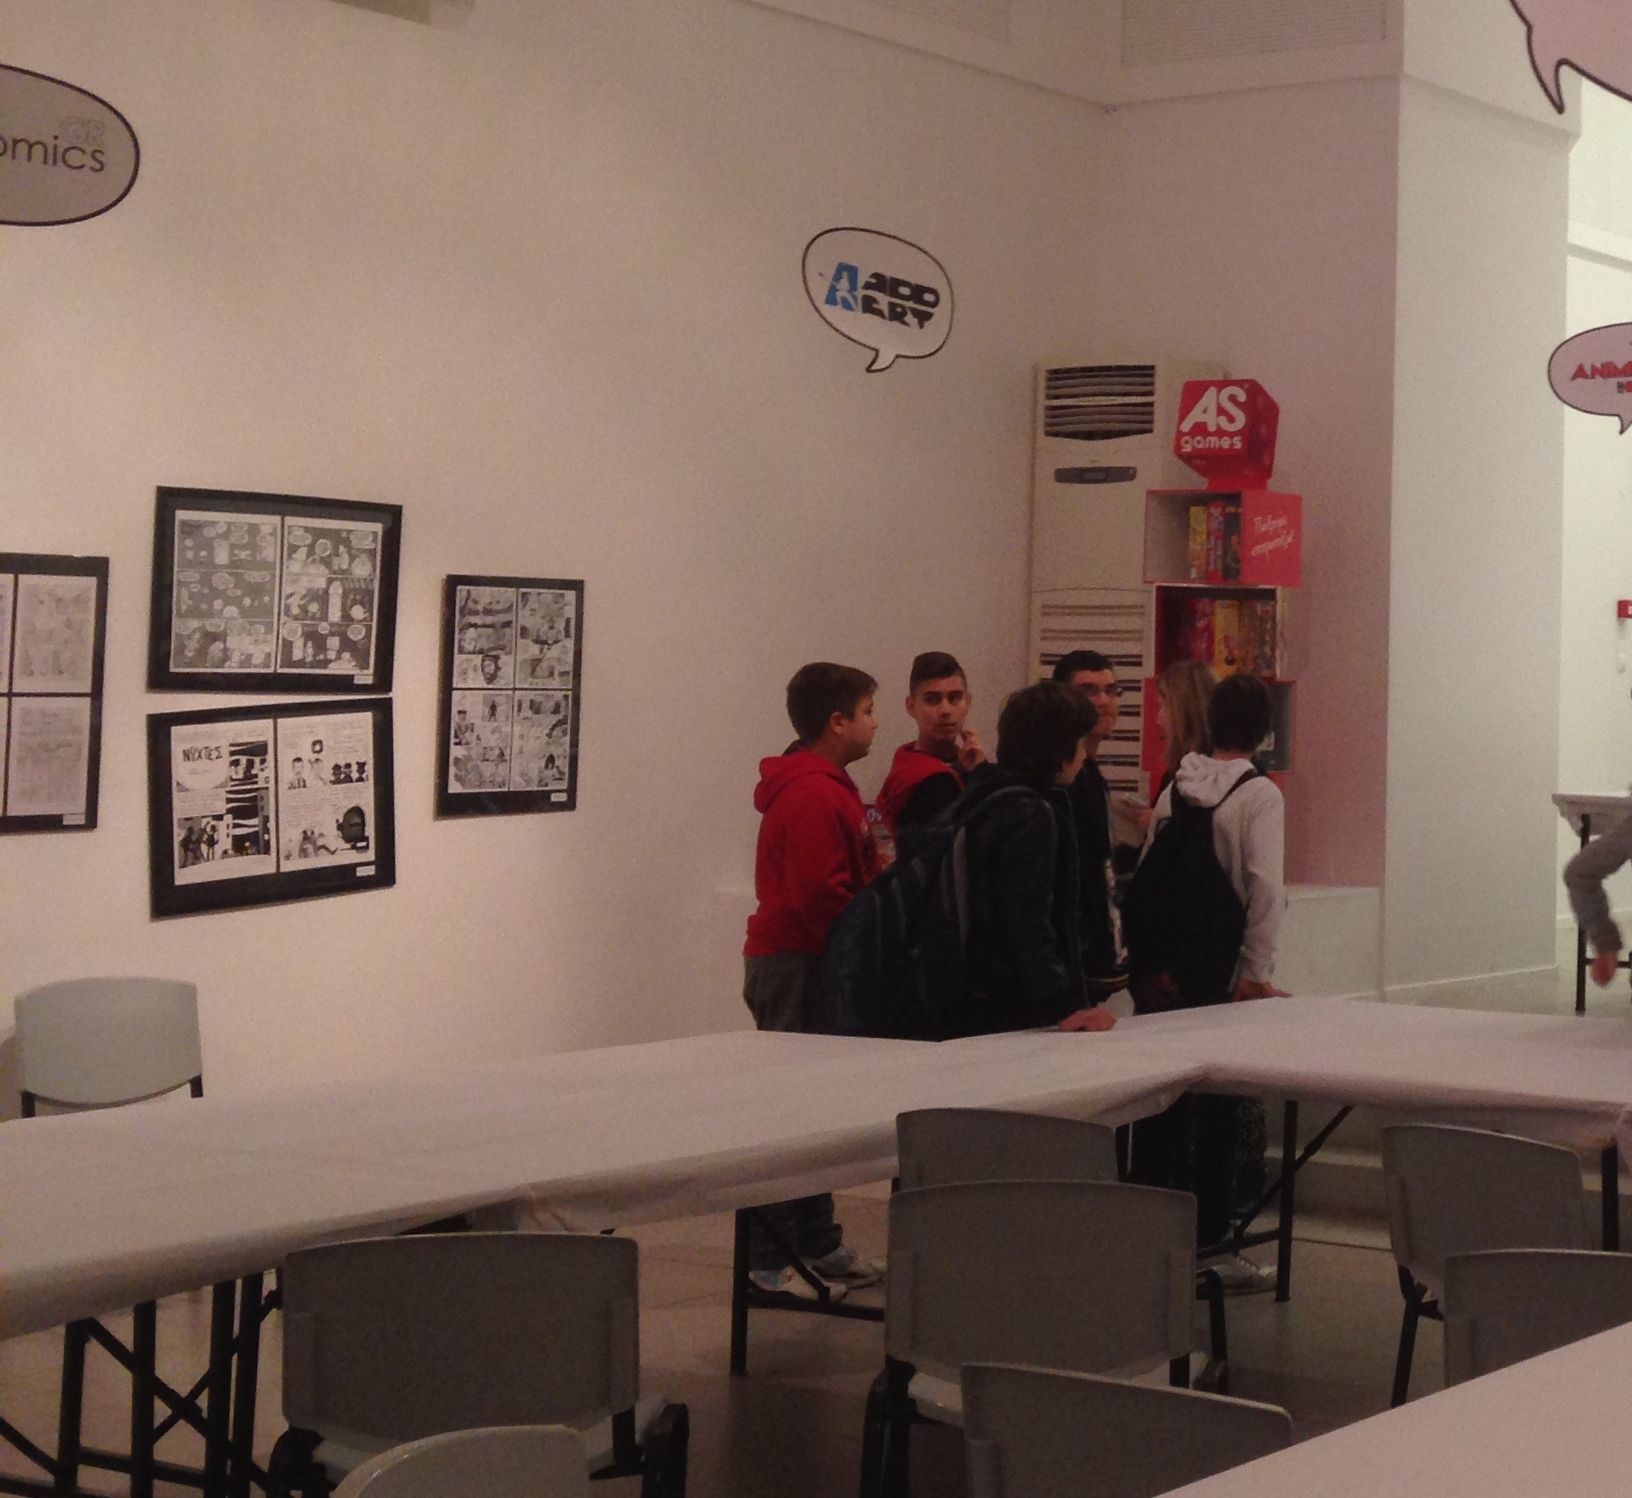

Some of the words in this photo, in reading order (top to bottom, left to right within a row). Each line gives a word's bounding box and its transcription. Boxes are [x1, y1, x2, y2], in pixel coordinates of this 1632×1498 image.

[0, 135, 105, 172] mics
[1180, 385, 1247, 432] AS
[1180, 435, 1243, 452] games
